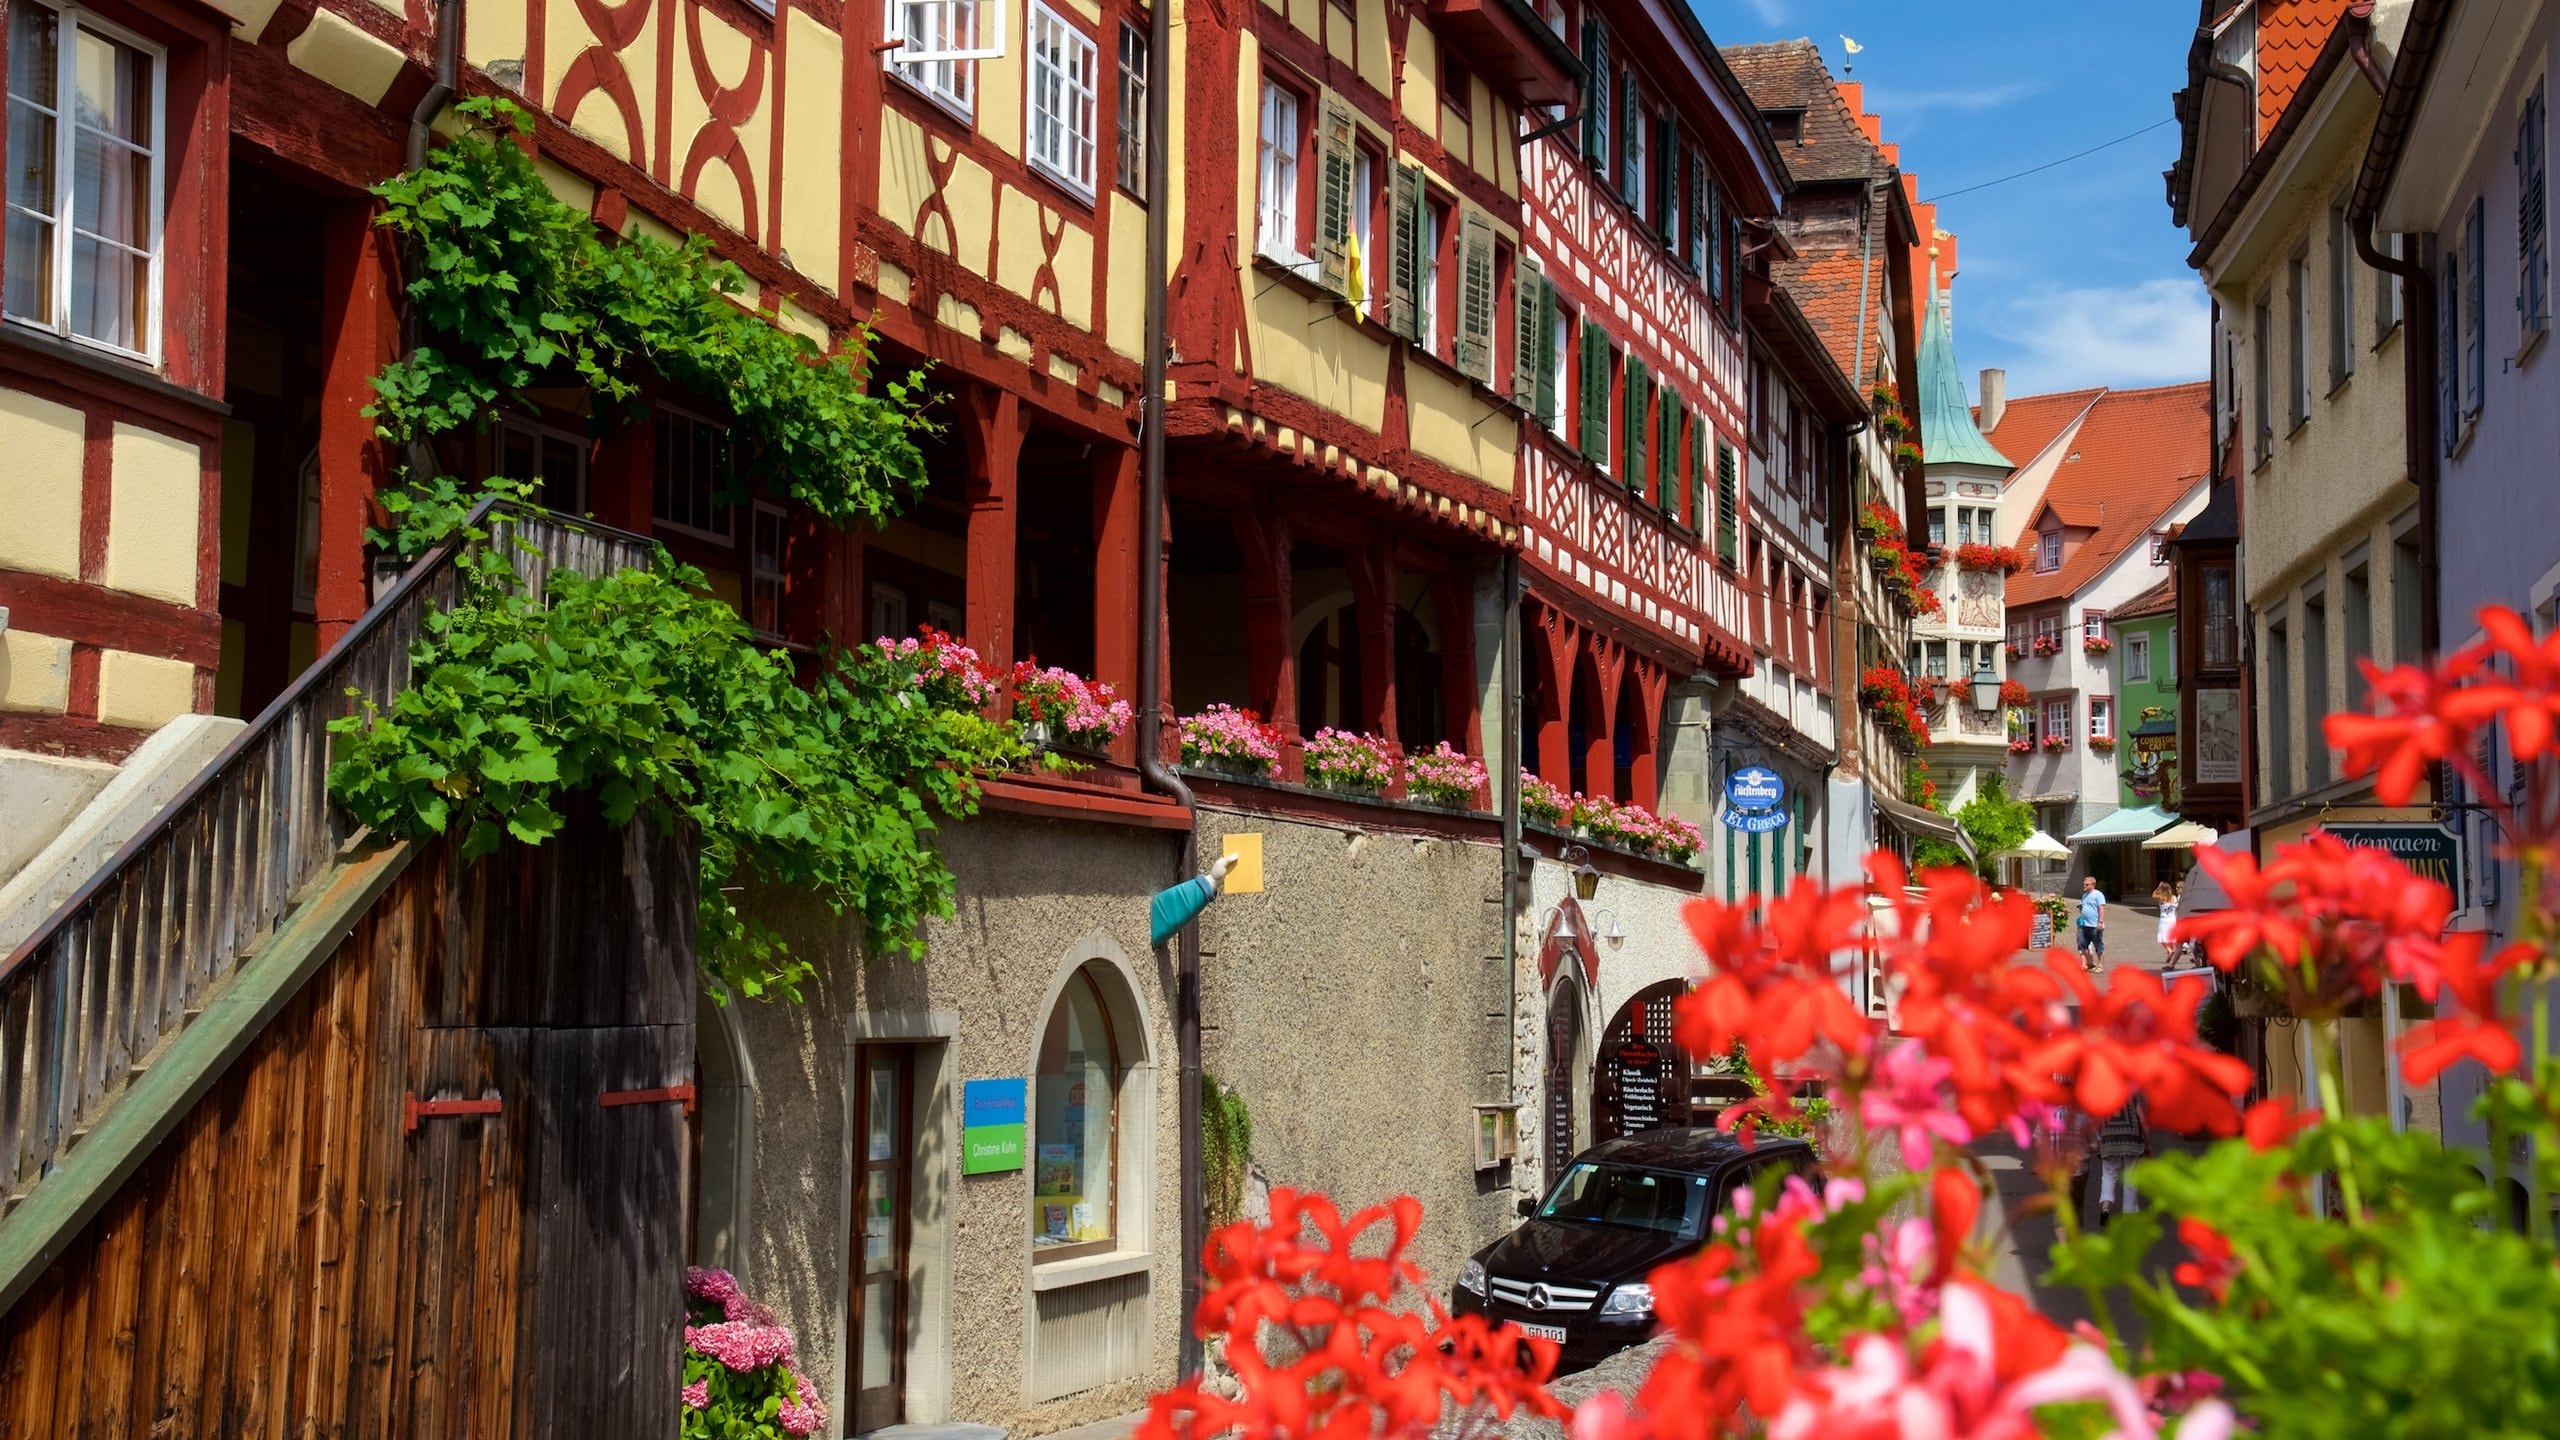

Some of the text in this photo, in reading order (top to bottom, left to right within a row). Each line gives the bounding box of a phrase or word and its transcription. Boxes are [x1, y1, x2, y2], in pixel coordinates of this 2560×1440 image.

[1734, 784, 1777, 799] Fürstenberg
[1726, 810, 1744, 828] EL
[1623, 1103, 1653, 1111] Vegetarisch
[973, 1144, 1000, 1157] Christine
[1545, 1329, 1564, 1341] 101
